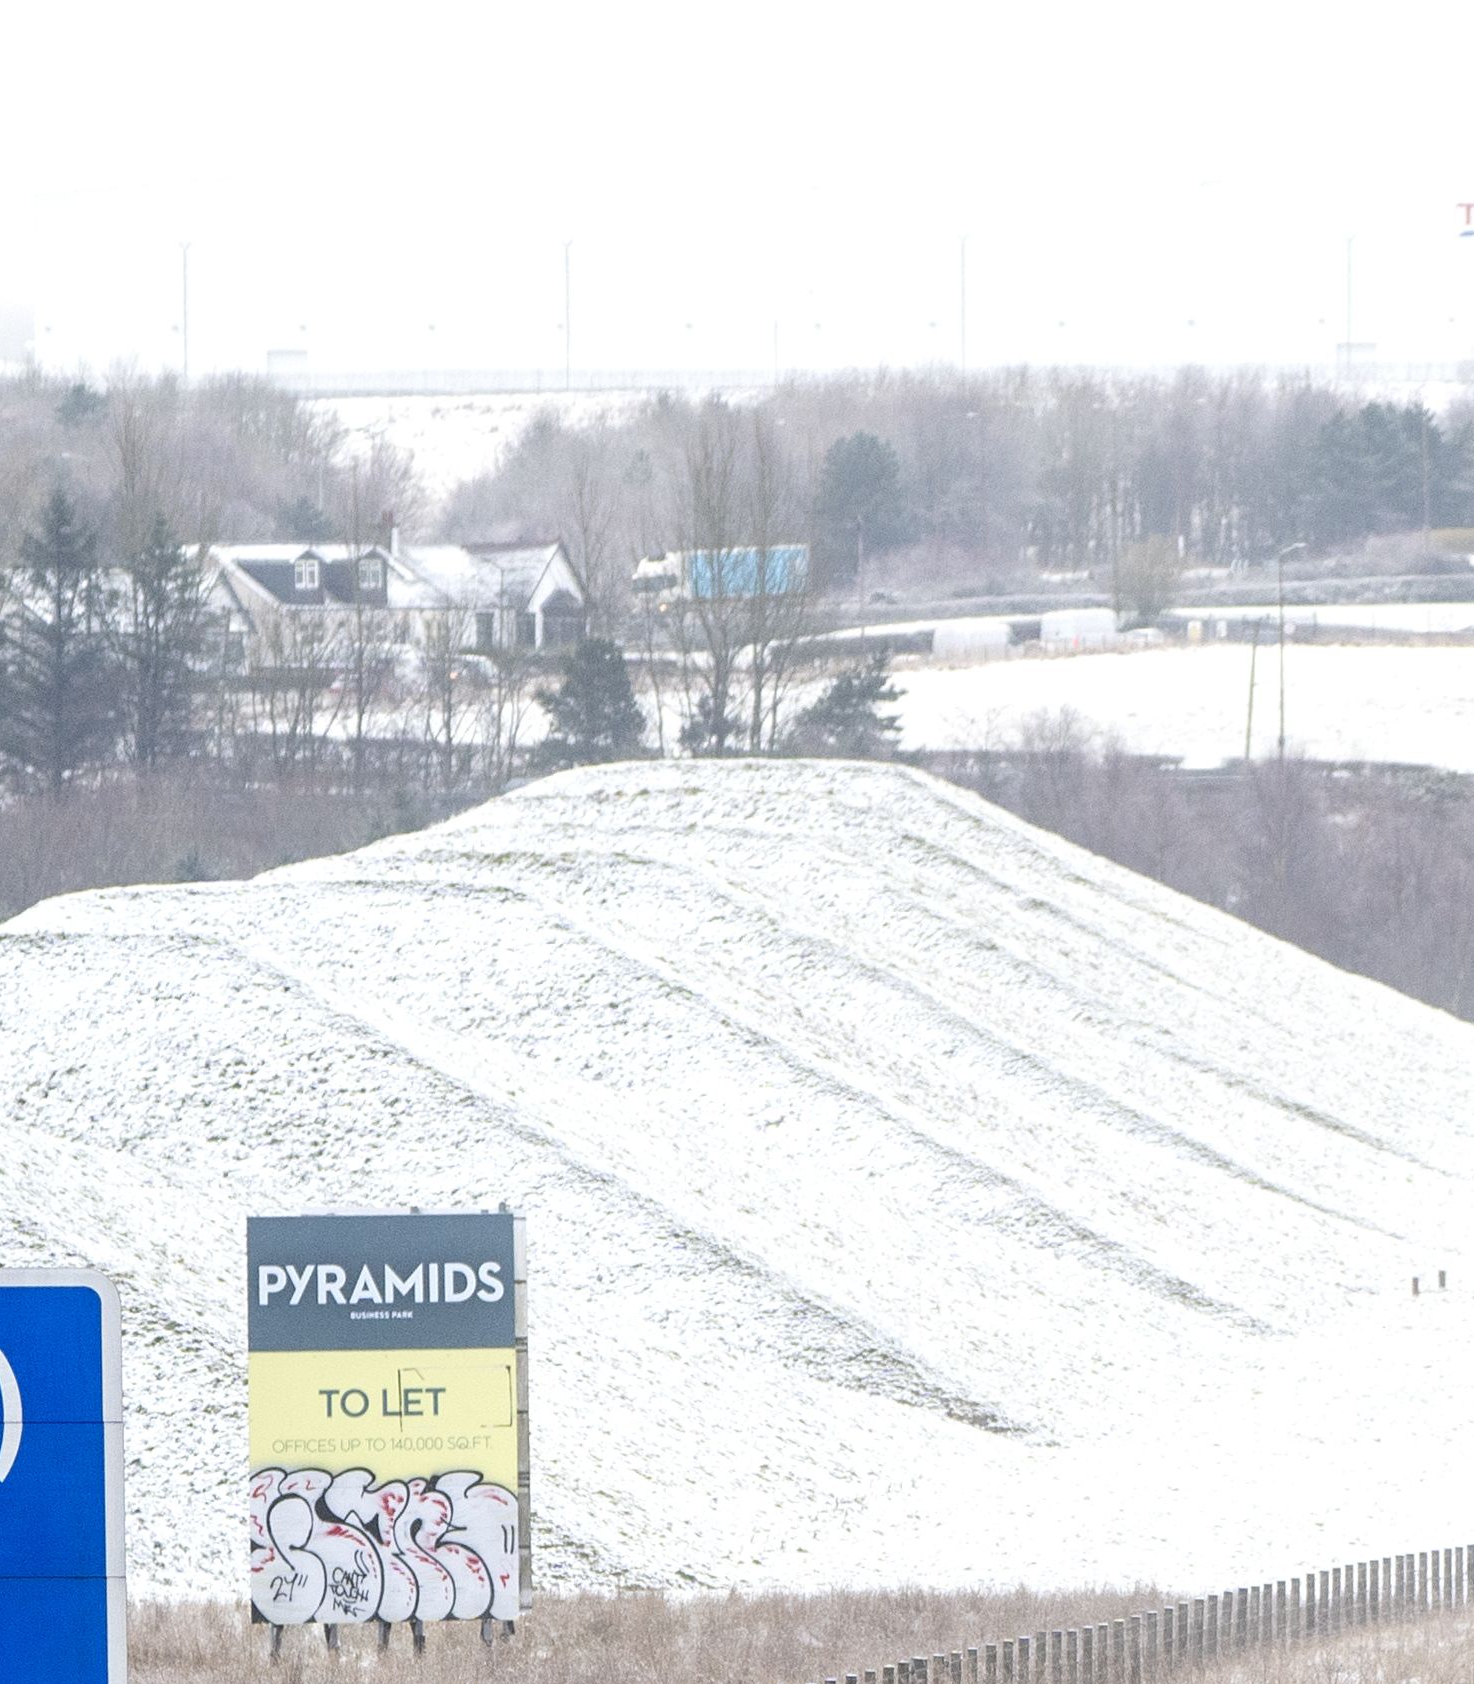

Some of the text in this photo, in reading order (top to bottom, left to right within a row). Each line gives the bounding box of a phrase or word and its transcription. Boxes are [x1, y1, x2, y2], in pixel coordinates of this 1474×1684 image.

[258, 1261, 505, 1307] PYRAMIDS
[391, 1310, 414, 1320] PARK
[318, 1388, 446, 1418] TO LET
[271, 1438, 337, 1454] OFFICES
[340, 1438, 362, 1453] UP
[364, 1438, 387, 1453] TO
[390, 1436, 444, 1453] 140,000
